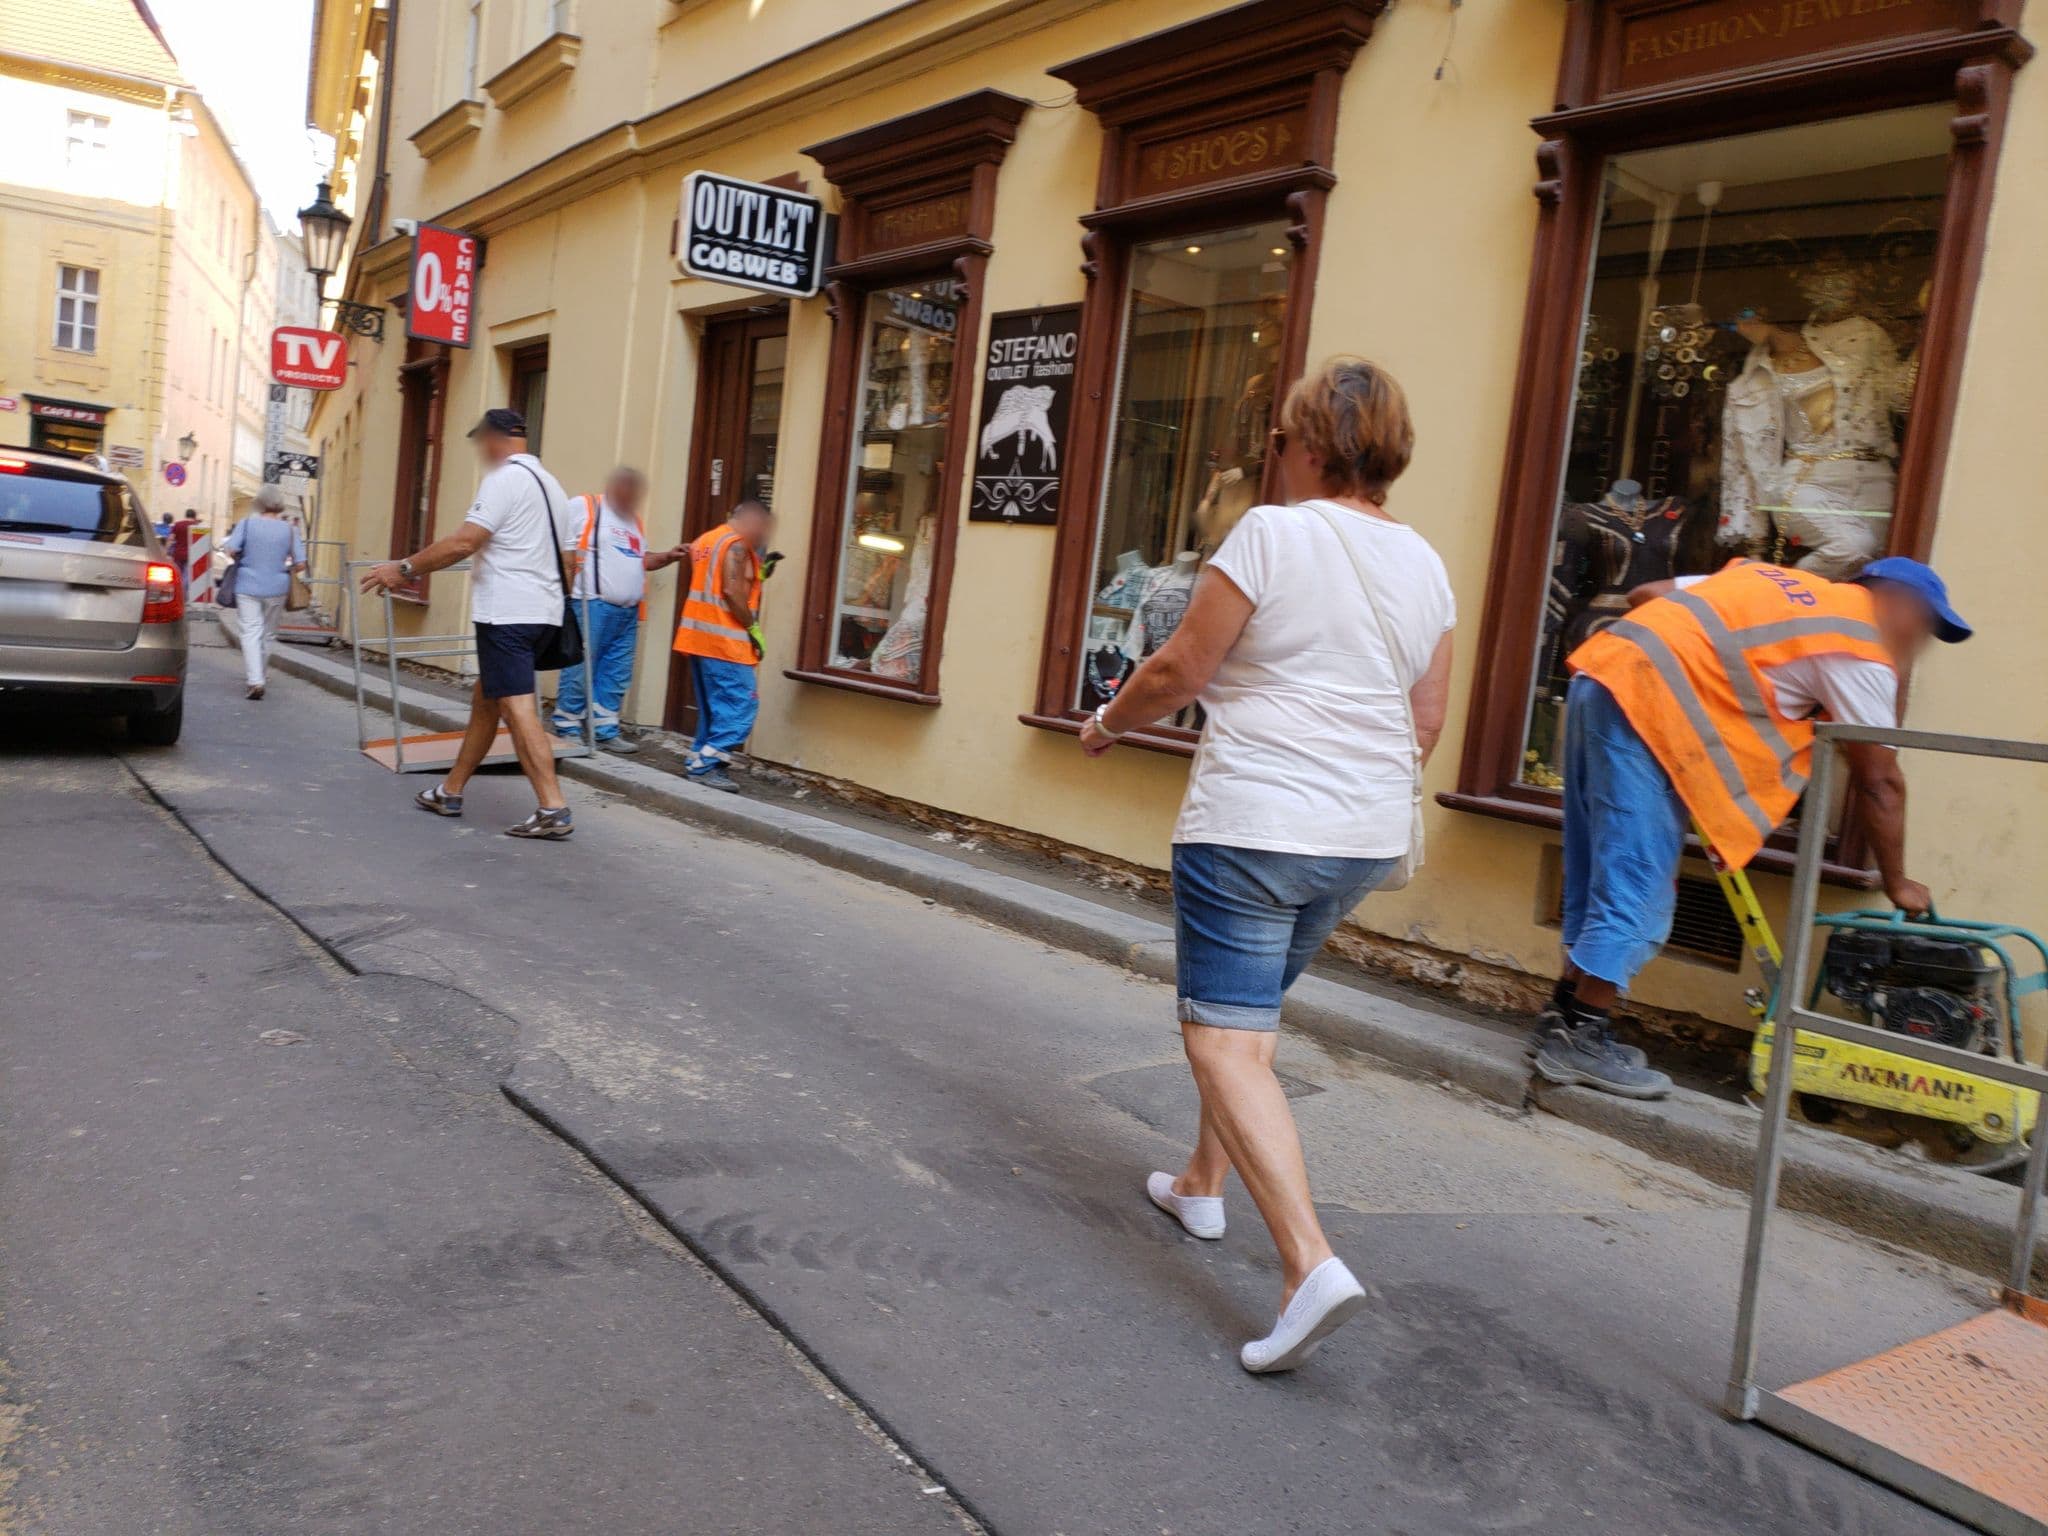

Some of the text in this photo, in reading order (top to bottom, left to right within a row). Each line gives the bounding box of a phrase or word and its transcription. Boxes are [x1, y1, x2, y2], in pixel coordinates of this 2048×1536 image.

[1625, 10, 1768, 65] FASHION
[1168, 126, 1268, 180] SHOES
[695, 181, 814, 253] OUTLET
[416, 252, 453, 313] 0%
[691, 243, 798, 284] COBWEB
[451, 238, 473, 341] CHANGE
[276, 333, 342, 370] TV
[986, 360, 1074, 381] OUTLET fashion
[989, 332, 1078, 364] STEFANO
[1755, 568, 1816, 606] DAP
